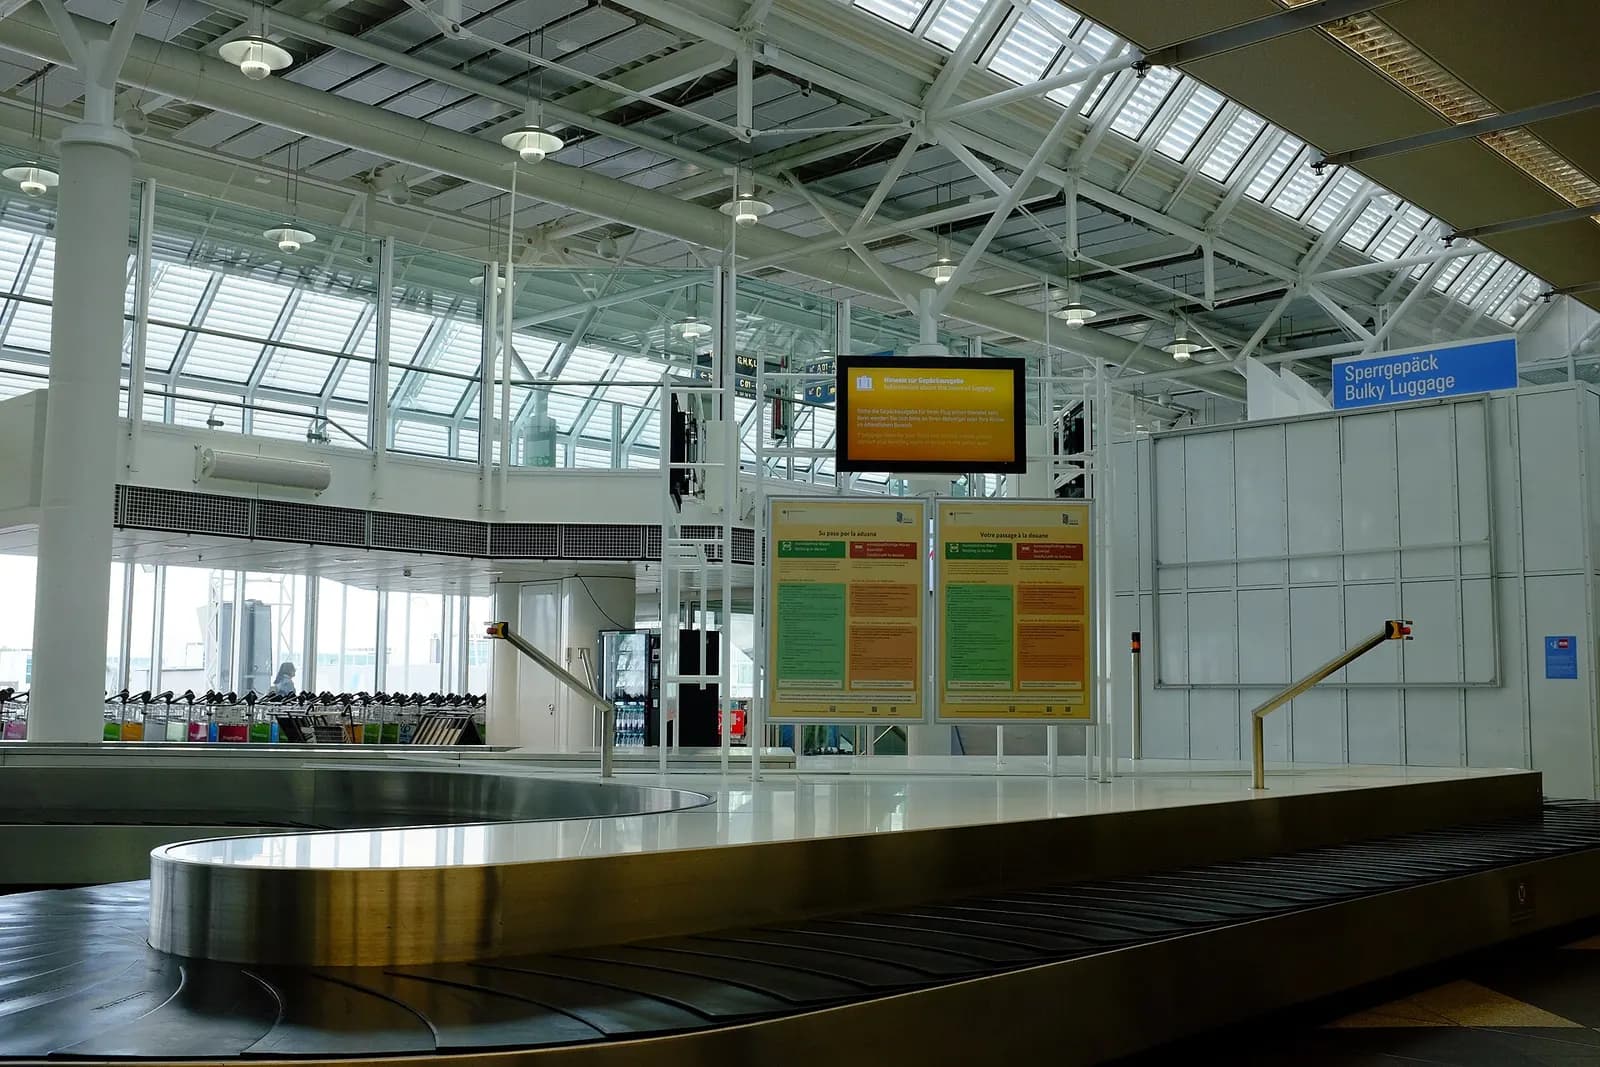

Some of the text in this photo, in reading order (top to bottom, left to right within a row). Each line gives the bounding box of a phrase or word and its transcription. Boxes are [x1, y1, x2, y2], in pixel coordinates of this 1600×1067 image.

[1344, 354, 1438, 384] Sperrgepäck
[1345, 375, 1455, 401] Bulky Luggage
[996, 532, 1017, 540] passage
